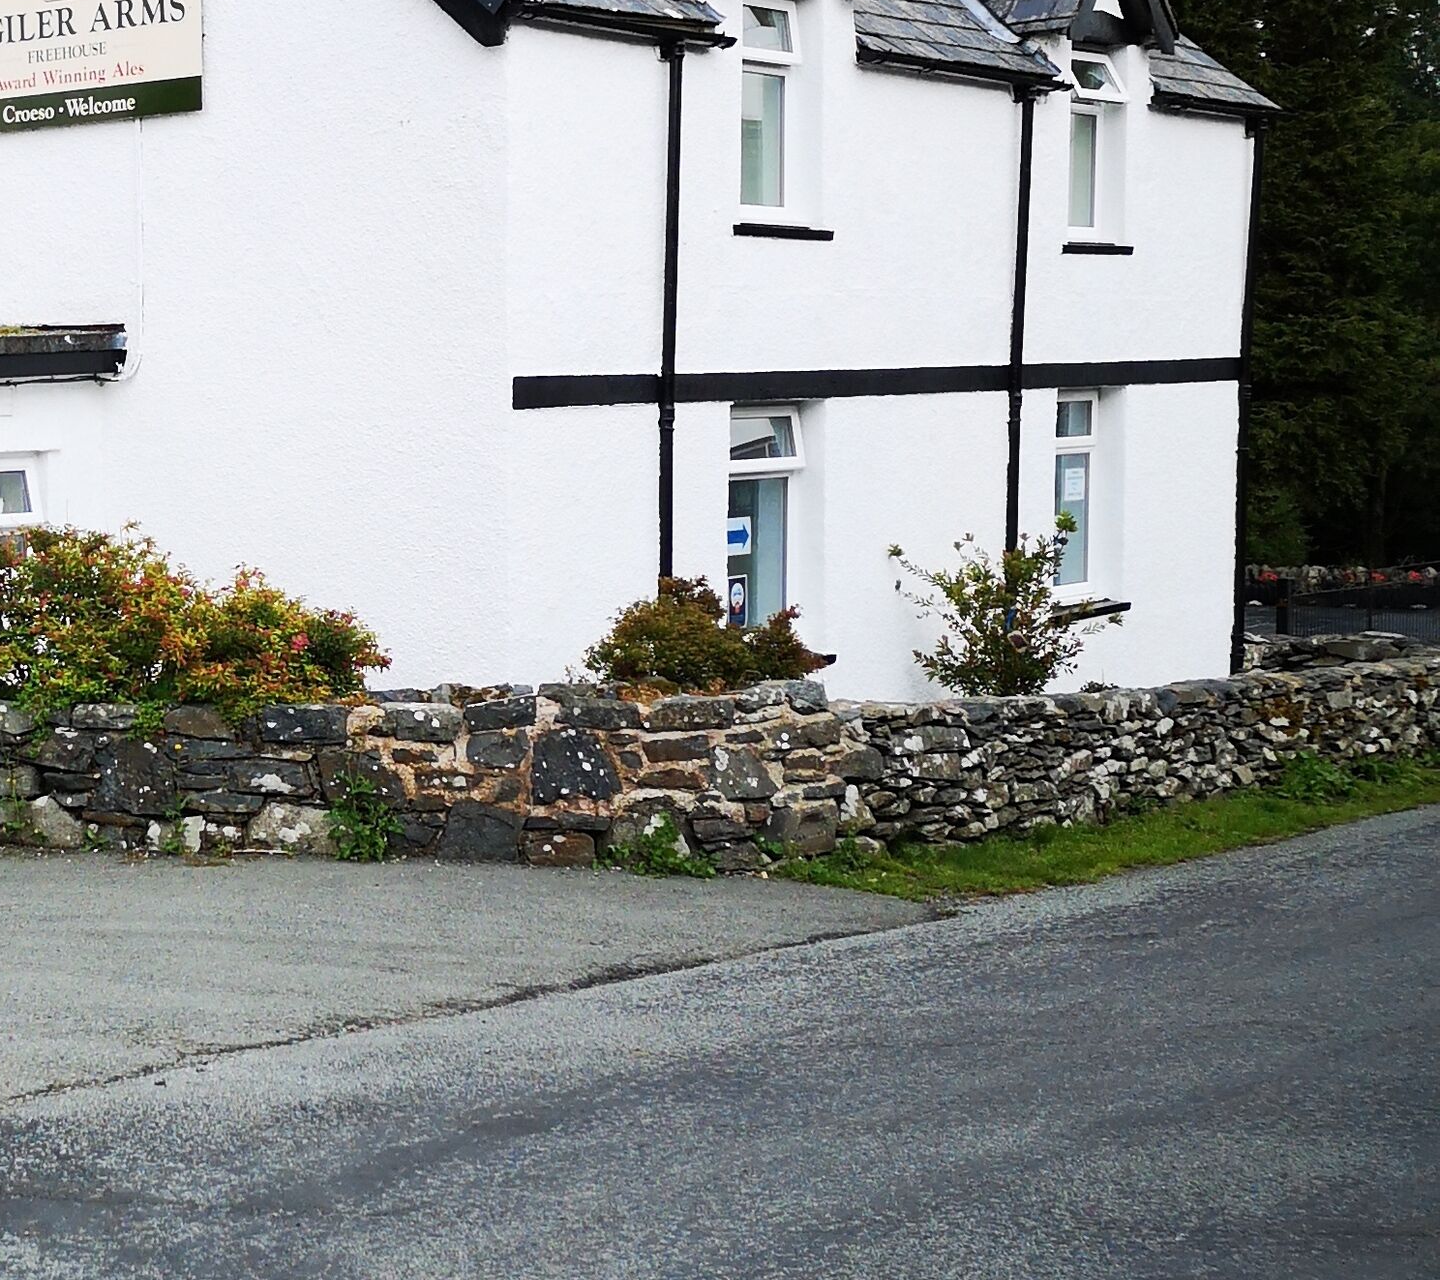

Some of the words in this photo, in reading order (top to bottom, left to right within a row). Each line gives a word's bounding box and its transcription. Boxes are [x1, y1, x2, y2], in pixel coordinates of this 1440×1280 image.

[28, 42, 107, 63] FREEHOUSE
[43, 66, 106, 85] Winning
[113, 61, 144, 78] Ales
[2, 105, 55, 124] Croeso
[65, 96, 136, 118] Welcome
